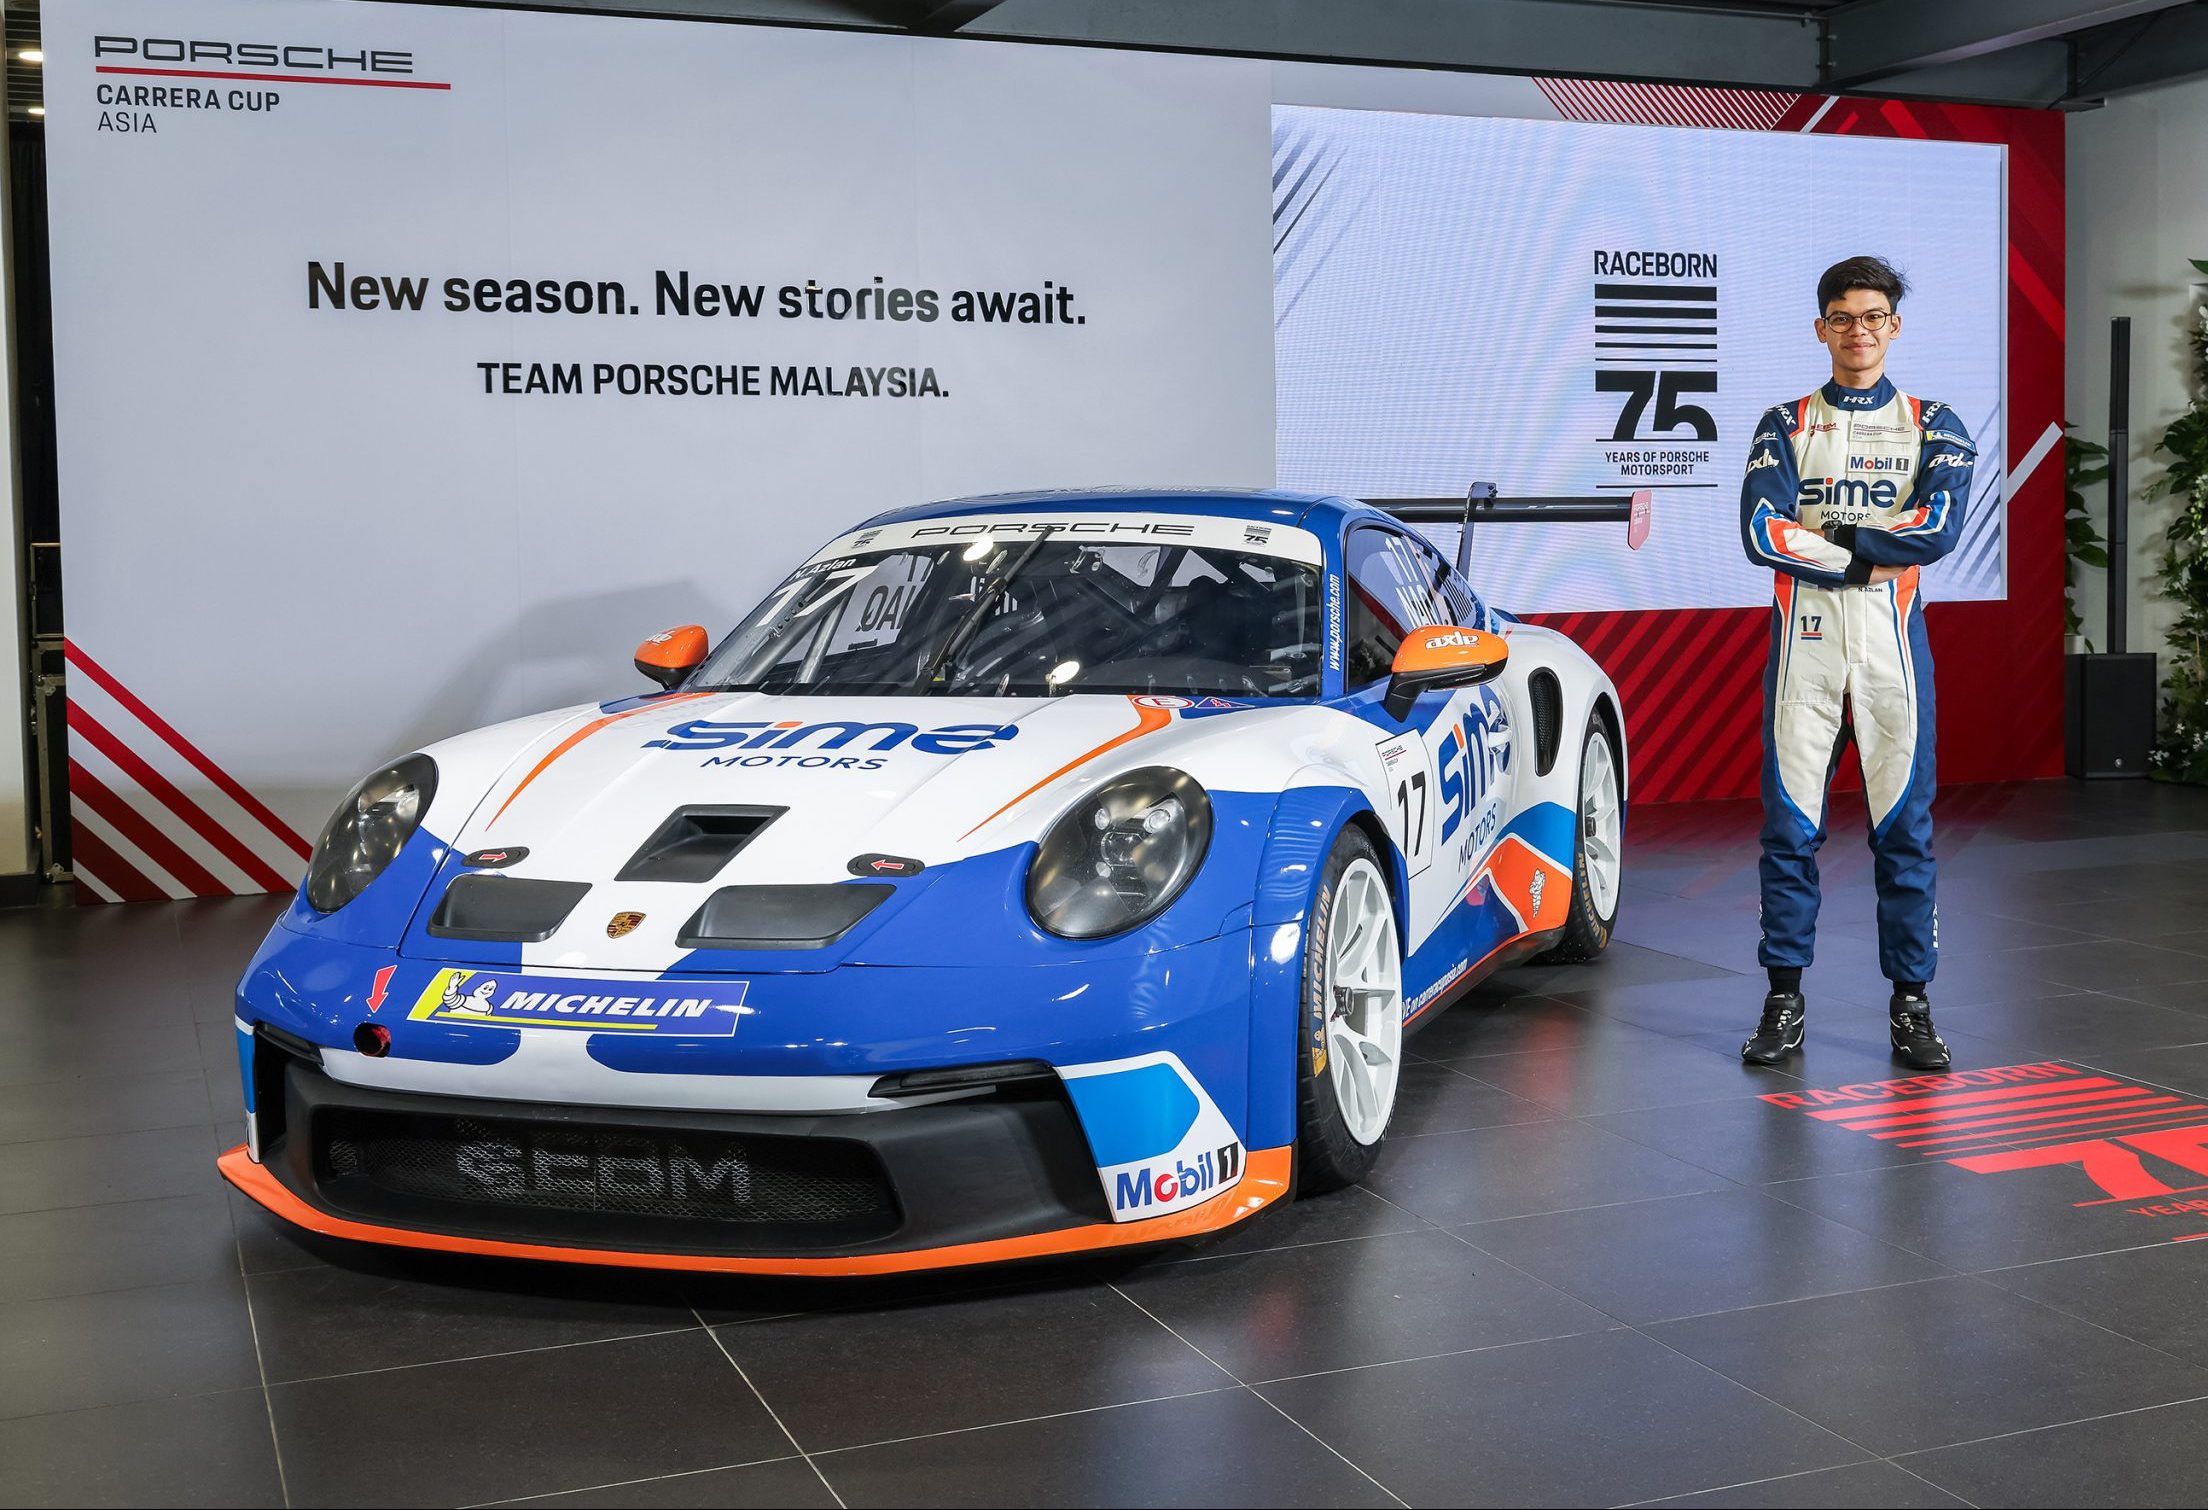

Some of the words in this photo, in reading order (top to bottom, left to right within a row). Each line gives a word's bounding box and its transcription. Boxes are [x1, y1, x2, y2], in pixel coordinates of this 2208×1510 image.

[94, 35, 413, 74] PORSCHE
[96, 83, 221, 110] CARRERA
[228, 90, 280, 112] CUP
[97, 110, 157, 134] ASIA
[1593, 250, 1718, 278] RACEBORN
[308, 261, 430, 311] New
[443, 277, 639, 315] season.
[655, 270, 766, 318] New
[778, 276, 940, 323] stories
[951, 281, 1086, 325] await.
[476, 362, 583, 394] TEAM
[593, 363, 760, 396] PORSCHE
[770, 365, 949, 398] MALAYSIA.
[1594, 369, 1718, 442] 75
[1605, 451, 1640, 463] YEARS
[1643, 451, 1657, 463] OF
[1659, 451, 1709, 462] PORSCHE
[1620, 464, 1695, 476] MOTORSPORT
[1850, 456, 1892, 470] Mobil
[911, 522, 1195, 539] PORSCHE
[755, 565, 880, 628] 17
[1326, 574, 1344, 672] www.porsche.com
[1800, 615, 1822, 632] 17
[699, 755, 889, 771] MOTORS
[1397, 770, 1426, 861] 17
[1458, 802, 1497, 873] MOTORS
[1312, 884, 1332, 1020] MICHELIN
[500, 991, 713, 1018] MICHELIN
[1755, 1060, 2083, 1110] RACEBORN
[1116, 1150, 1214, 1211] Mobil
